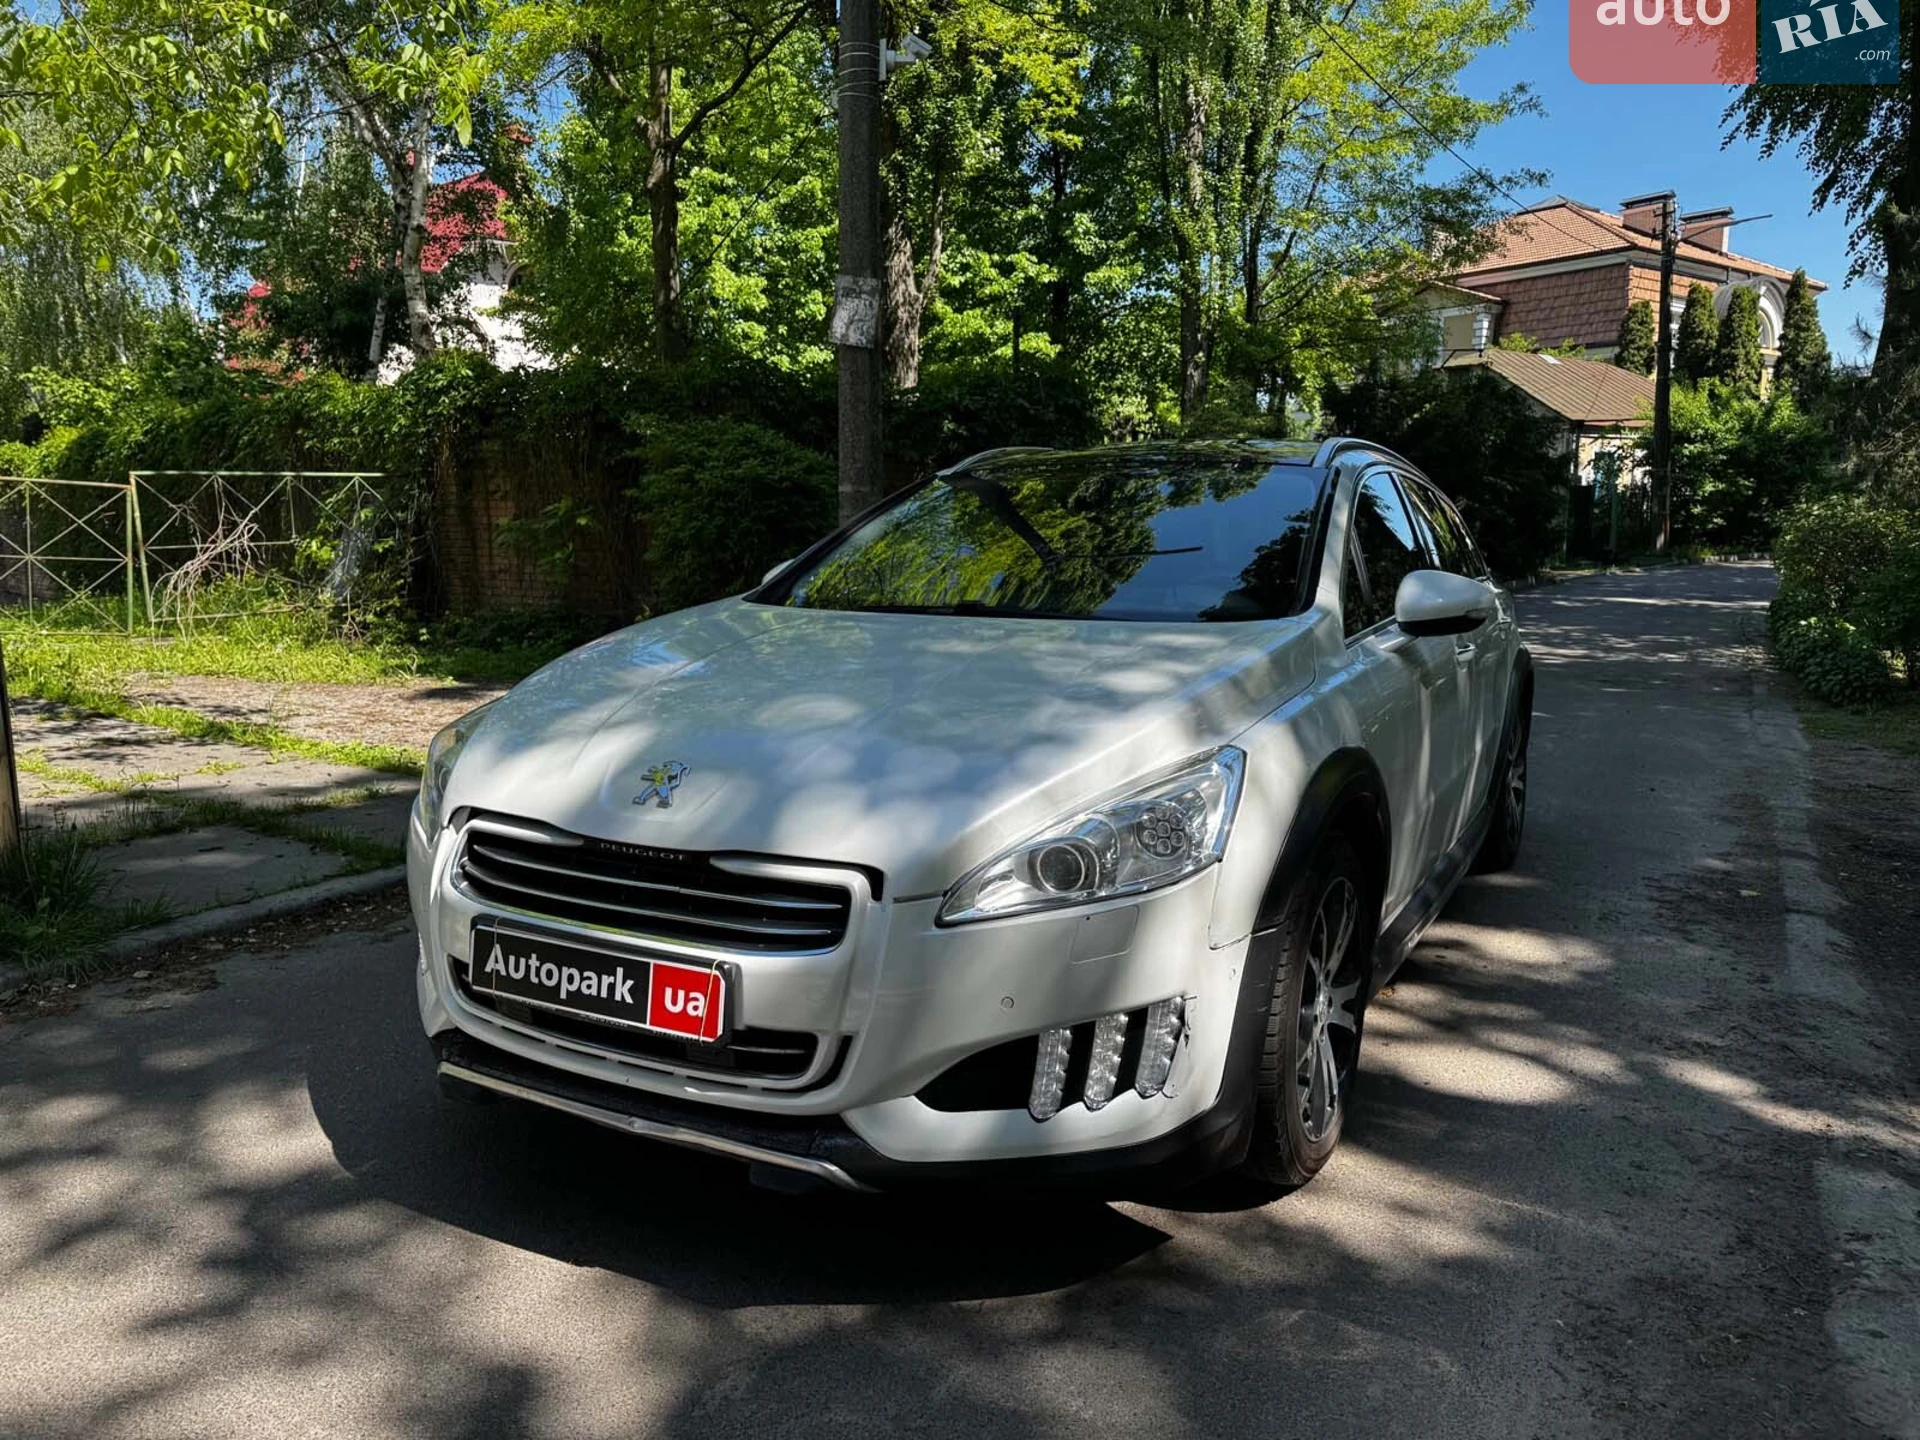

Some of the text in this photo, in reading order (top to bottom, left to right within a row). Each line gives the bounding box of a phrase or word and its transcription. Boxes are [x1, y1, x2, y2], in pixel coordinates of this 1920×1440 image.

[599, 840, 685, 862] PEUGEOT
[484, 943, 707, 1018] Autopark ua
